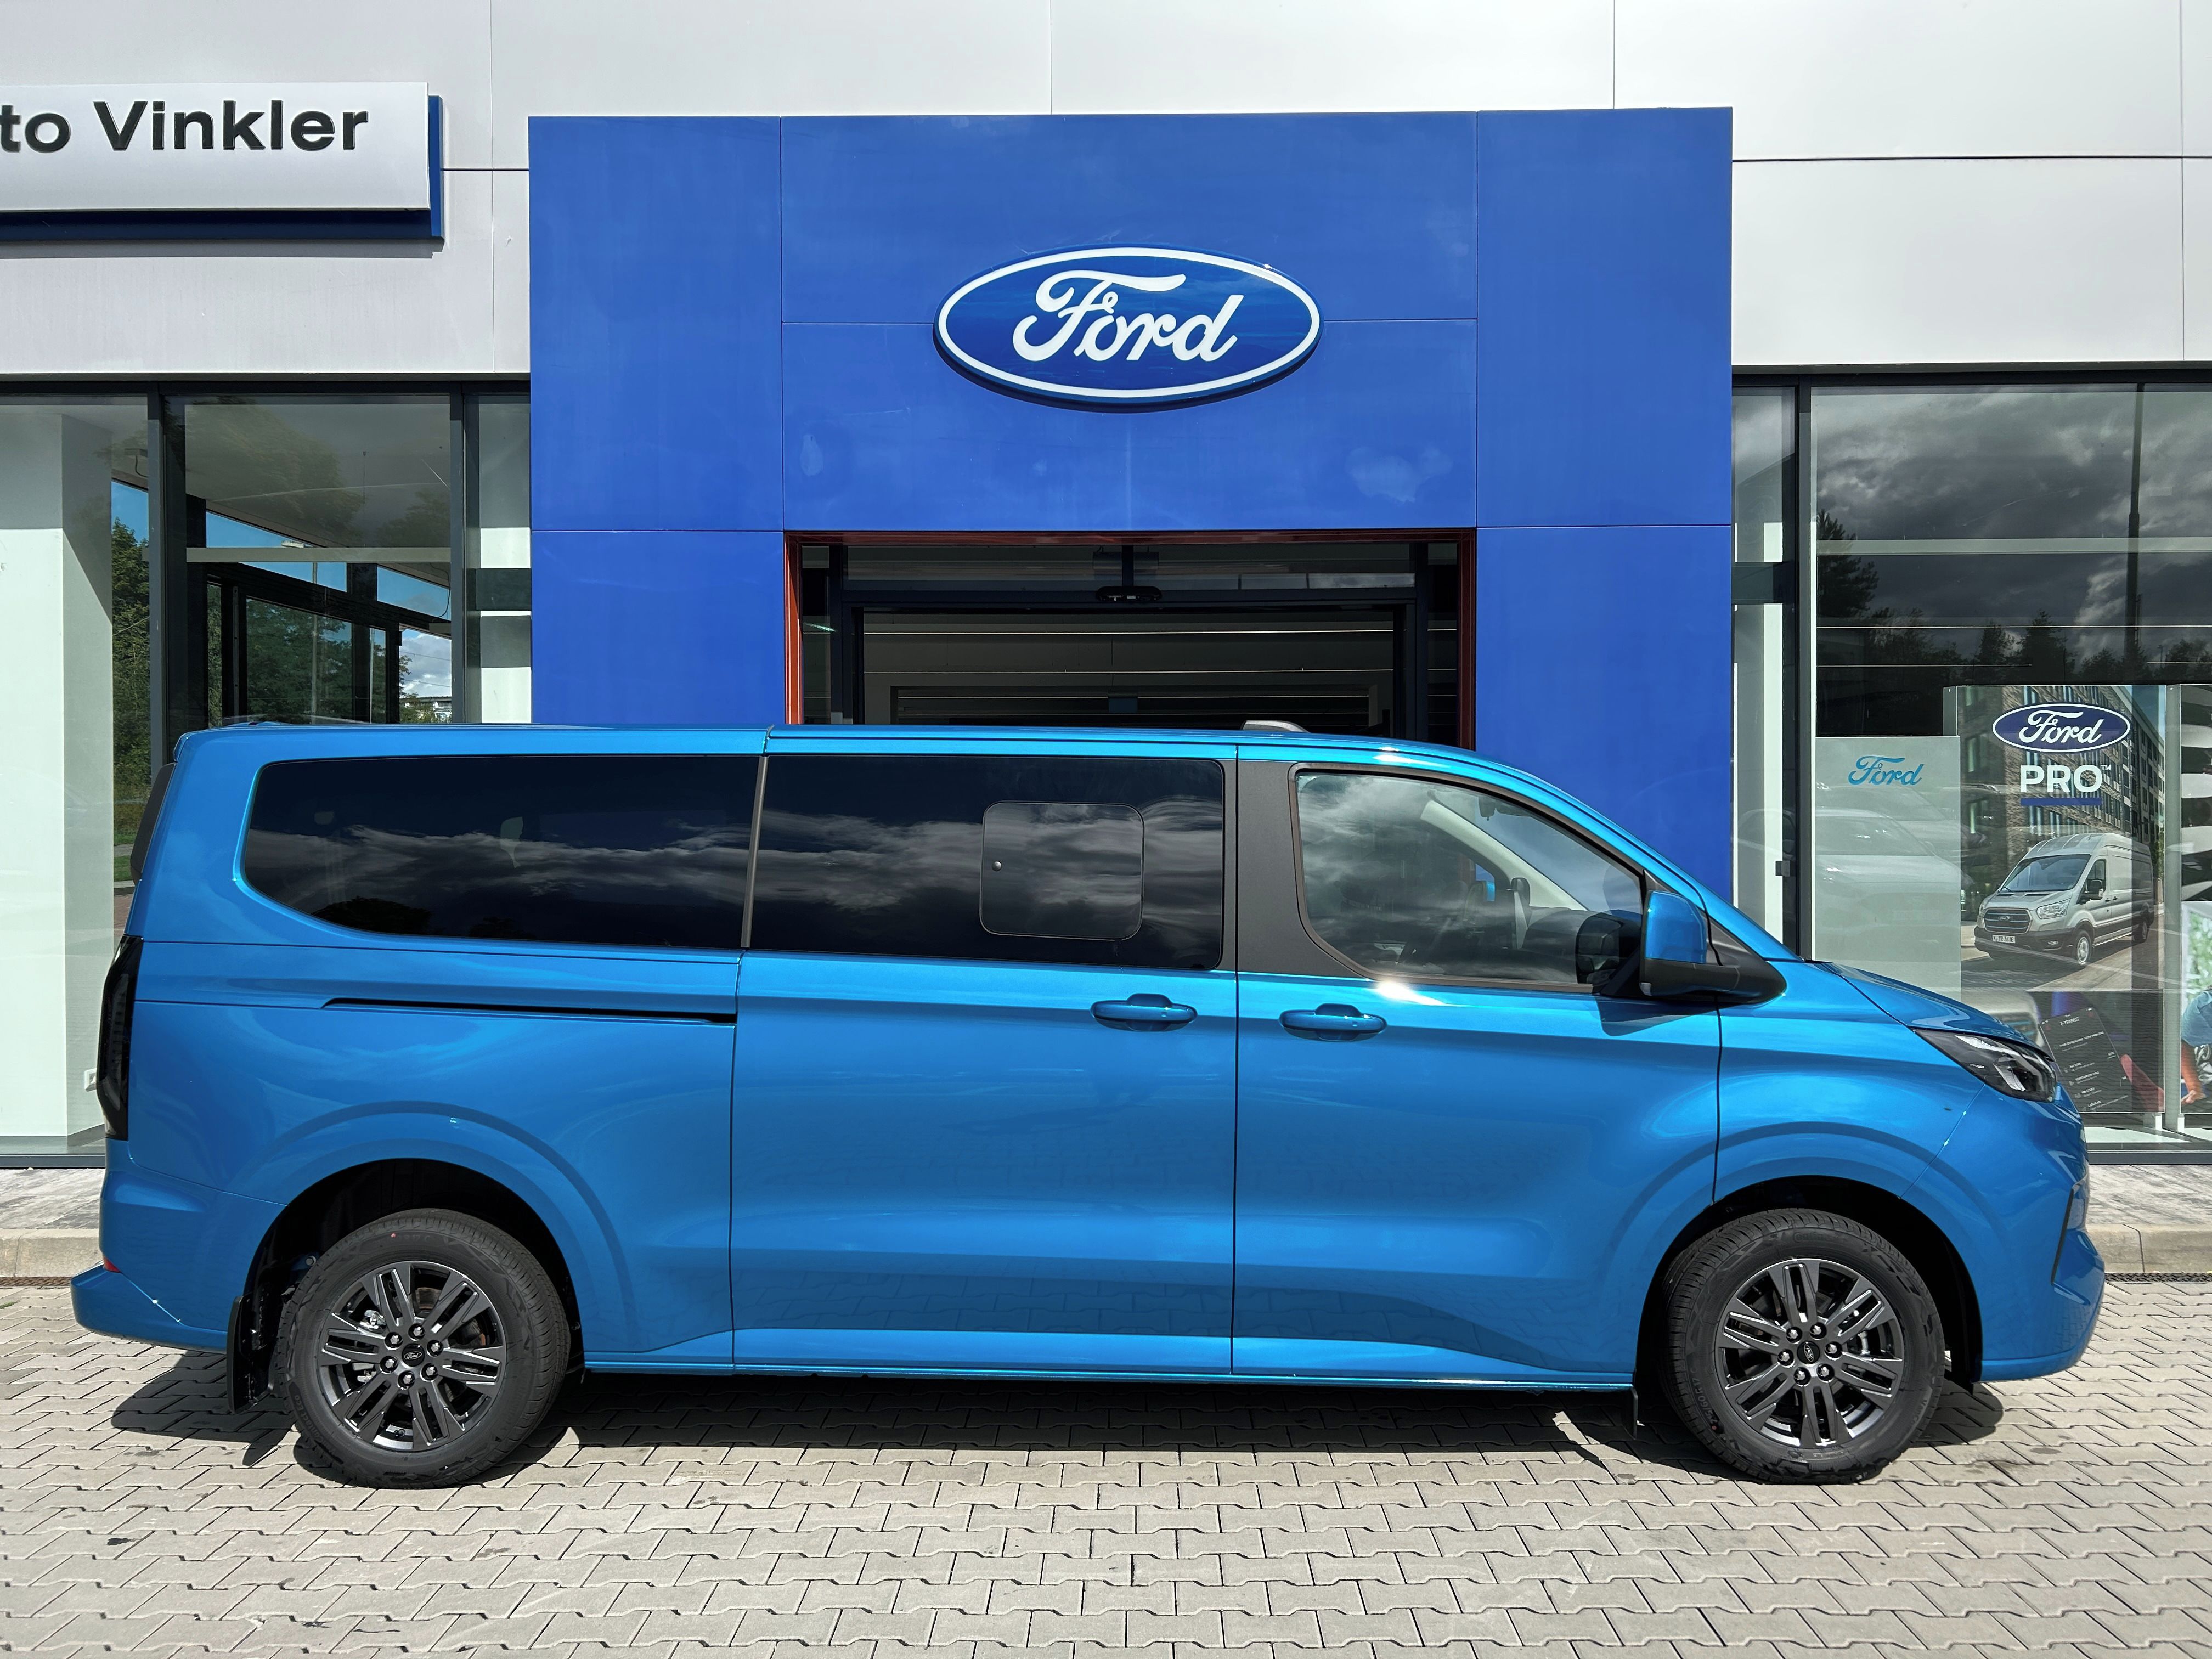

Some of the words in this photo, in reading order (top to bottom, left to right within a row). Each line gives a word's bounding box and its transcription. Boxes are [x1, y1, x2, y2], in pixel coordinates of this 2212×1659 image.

[94, 100, 369, 151] Vinkler
[1012, 269, 1245, 362] Ford
[2019, 710, 2104, 743] Ford
[1848, 755, 1925, 785] Ford
[293, 1395, 304, 1411] Eco
